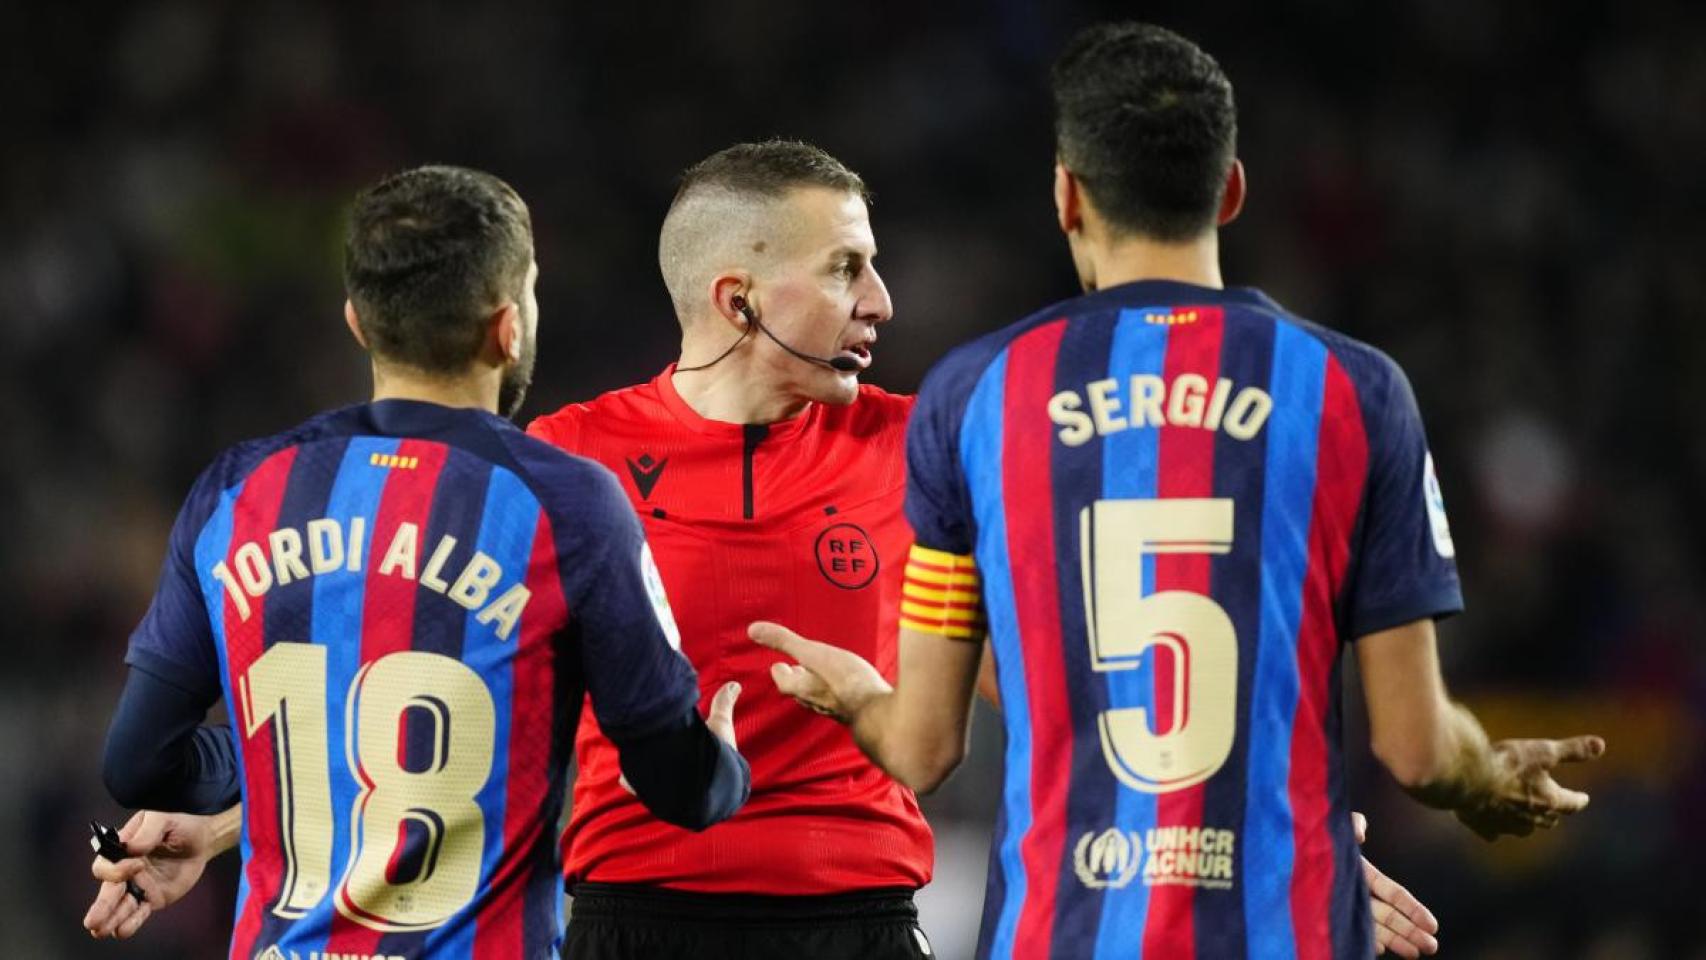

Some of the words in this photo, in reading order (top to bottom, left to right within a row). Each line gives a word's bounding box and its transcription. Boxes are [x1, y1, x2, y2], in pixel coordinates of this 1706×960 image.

[1047, 373, 1274, 447] SERGIO
[212, 516, 365, 622] JORDI
[378, 521, 532, 641] ALBA
[1079, 498, 1239, 794] 5
[239, 641, 496, 932] 18
[1143, 851, 1233, 878] ACNUR
[1146, 826, 1235, 853] UNHCR
